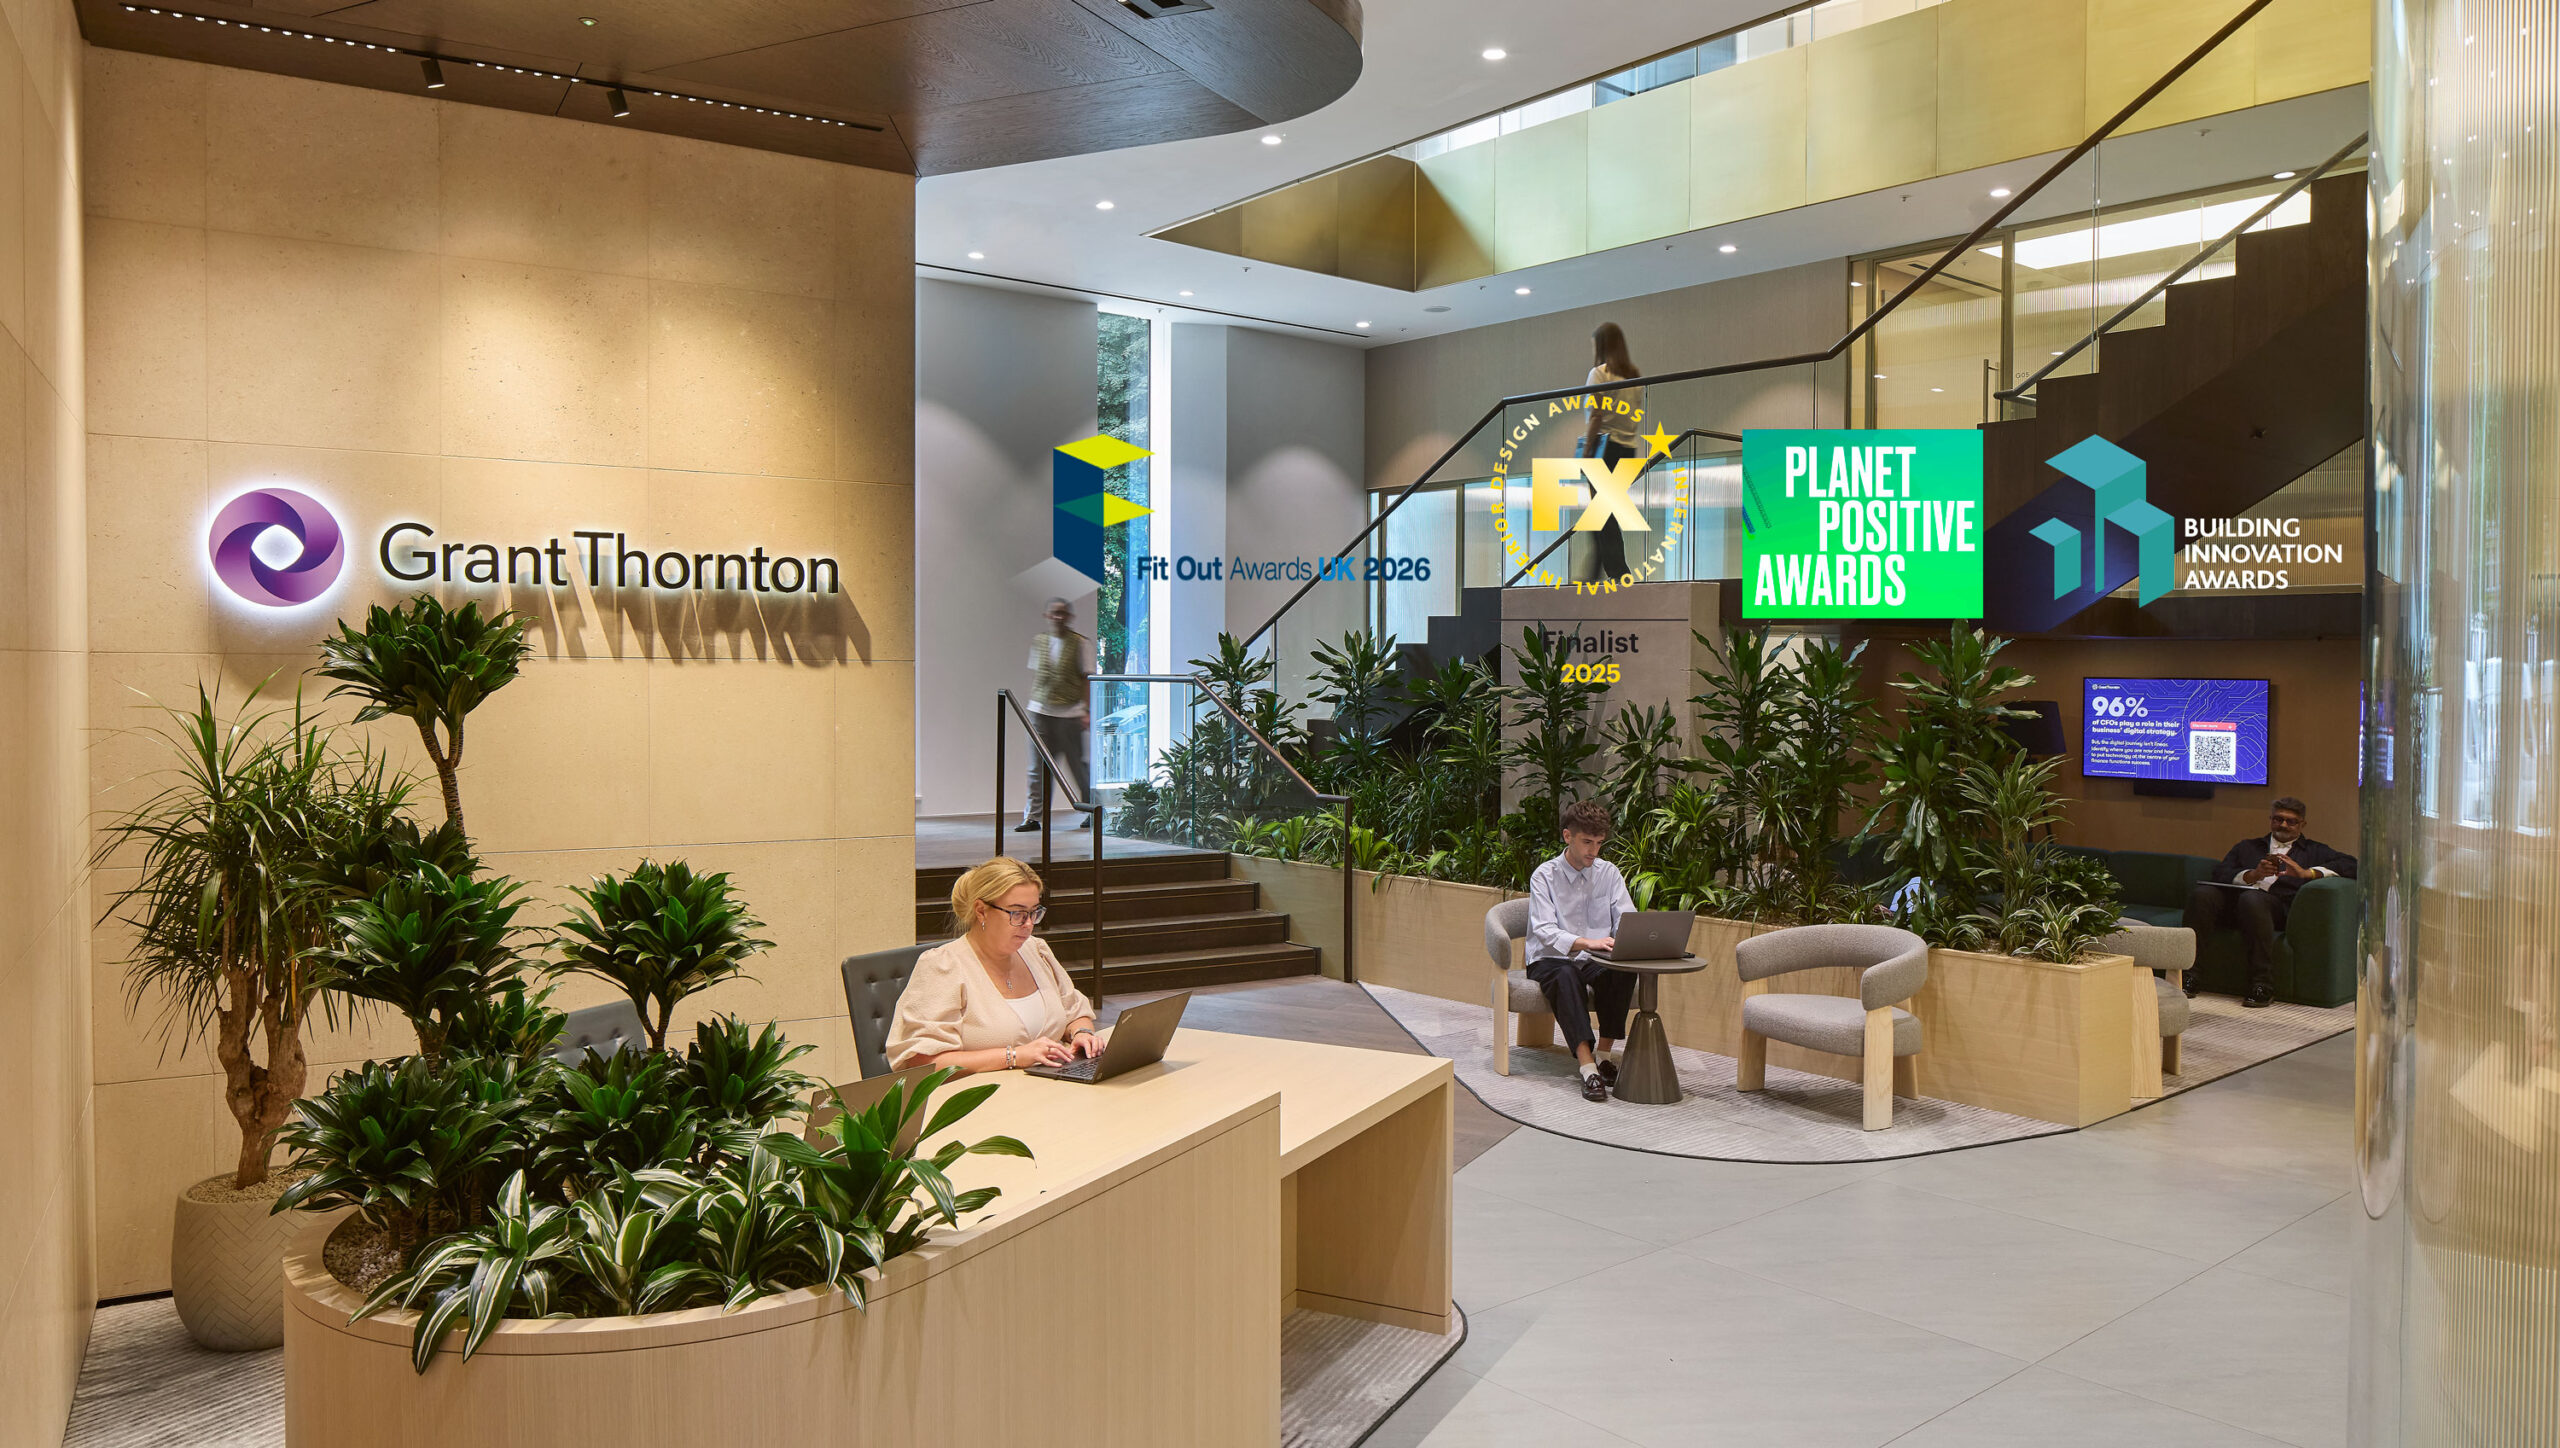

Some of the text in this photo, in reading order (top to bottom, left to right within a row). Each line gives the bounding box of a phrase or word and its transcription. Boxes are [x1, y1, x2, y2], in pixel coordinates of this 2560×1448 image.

[379, 522, 840, 595] Grant Thornton
[2092, 696, 2148, 717] 96%
[2119, 720, 2135, 728] play
[2123, 727, 2146, 736] digital
